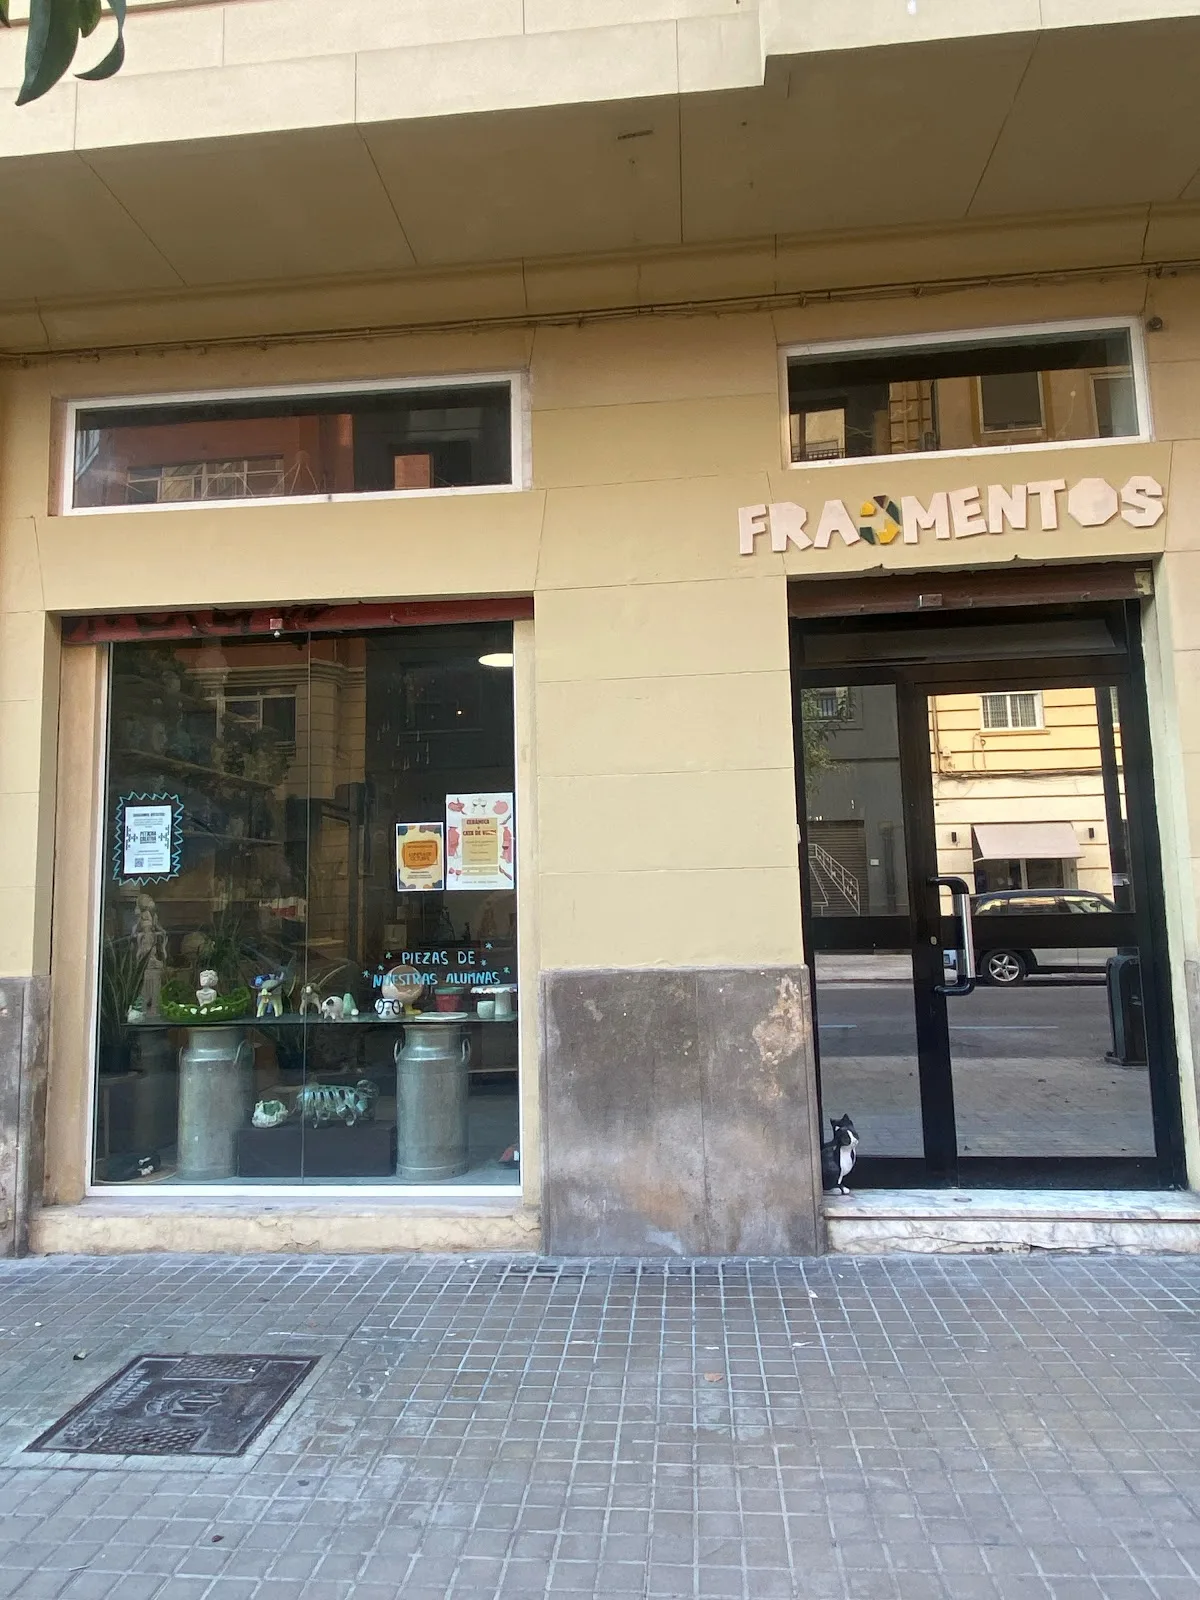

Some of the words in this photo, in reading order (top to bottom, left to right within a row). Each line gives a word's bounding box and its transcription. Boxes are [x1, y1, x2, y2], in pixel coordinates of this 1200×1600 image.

[737, 475, 1165, 555] FRAGMENTOS
[401, 950, 449, 965] PIEZAS
[457, 950, 476, 965] DE
[372, 972, 438, 988] NUESTRAS
[445, 971, 501, 985] ALUMNAS
